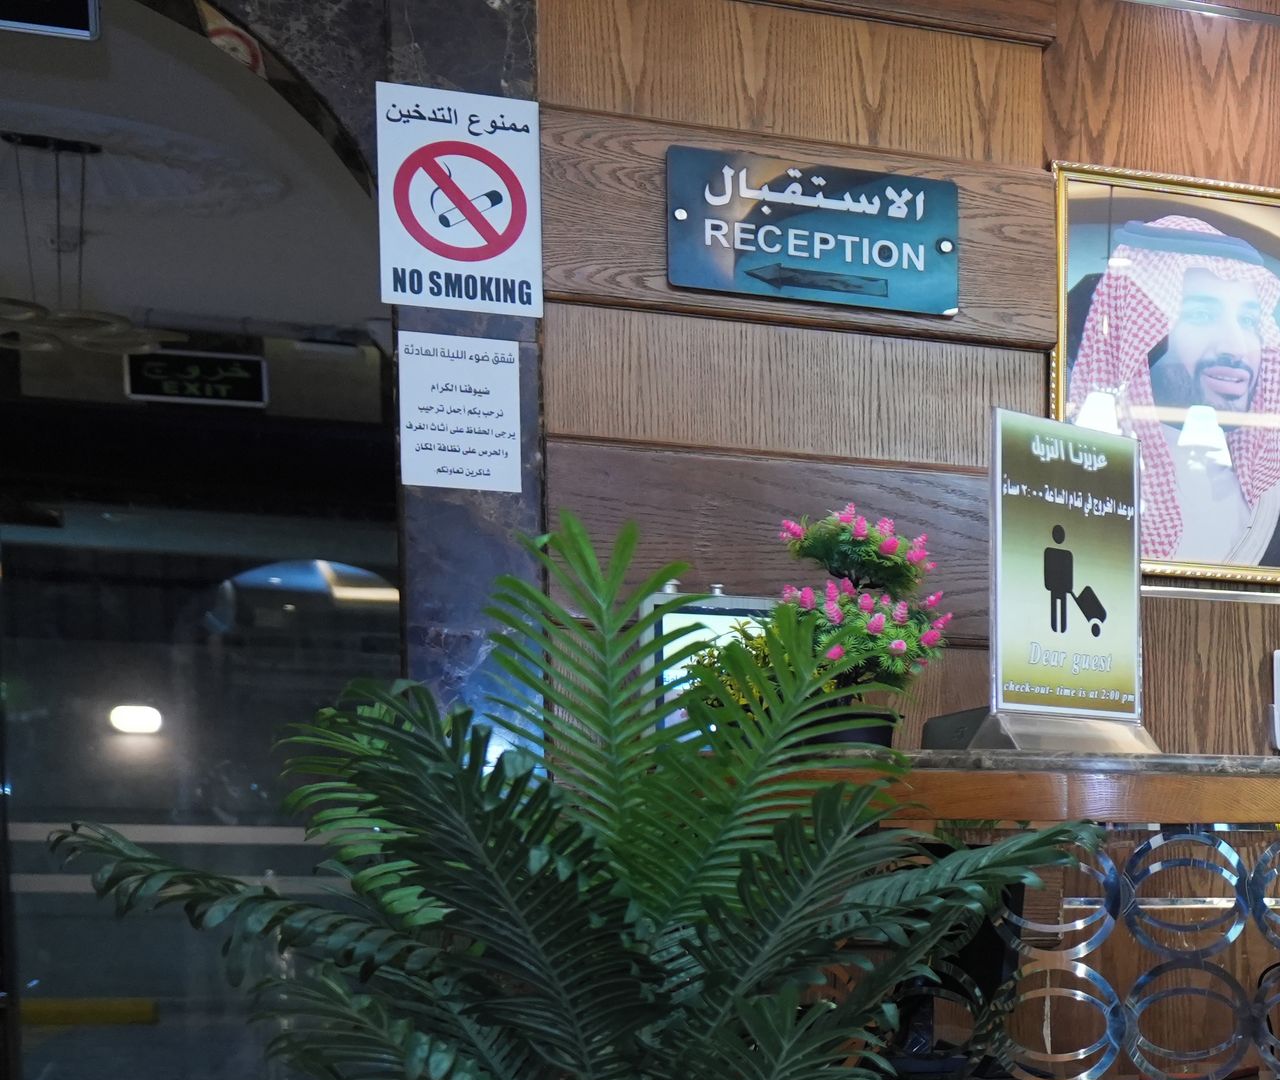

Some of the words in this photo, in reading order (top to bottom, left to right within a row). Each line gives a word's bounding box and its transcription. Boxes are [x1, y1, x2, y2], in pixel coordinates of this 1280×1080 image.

[385, 103, 458, 126] التدخين
[467, 113, 531, 136] ممنوع
[704, 164, 926, 222] الاستقبال
[704, 218, 926, 272] RECEPTION
[392, 267, 423, 295] NO
[428, 270, 533, 306] SMOKING
[404, 344, 438, 358] الهادئة
[440, 347, 466, 361] الليلة
[468, 352, 490, 363] ضوء
[492, 352, 515, 365] شقق
[163, 381, 233, 397] EXIT
[431, 383, 457, 393] الكرام
[459, 384, 490, 397] ضيوفنا
[418, 404, 444, 414] ترحيب
[467, 407, 481, 418] بكم
[482, 409, 504, 419] نرحب
[405, 421, 429, 431] الغرف
[450, 427, 464, 435] على
[466, 427, 494, 436] الحفاظ
[495, 431, 516, 440] يرجى
[415, 442, 436, 452] المكان
[437, 443, 461, 453] نظافة
[462, 447, 477, 456] على
[1031, 435, 1065, 461] النزيل
[1068, 442, 1107, 471] عزيزنا
[436, 466, 463, 475] تعاونكم
[465, 468, 491, 477] شاكرين
[1044, 484, 1068, 504] الساعة
[1069, 491, 1083, 510] تمام
[1084, 493, 1092, 517] في
[1093, 497, 1115, 516] الخروج
[1117, 502, 1134, 520] موعد
[1029, 641, 1067, 667] Dear
[1072, 652, 1112, 675] guest
[1056, 686, 1076, 697] time
[1079, 687, 1087, 698] is
[1089, 690, 1098, 699] at
[1101, 689, 1120, 701] 2:00
[1121, 692, 1135, 704] pm
